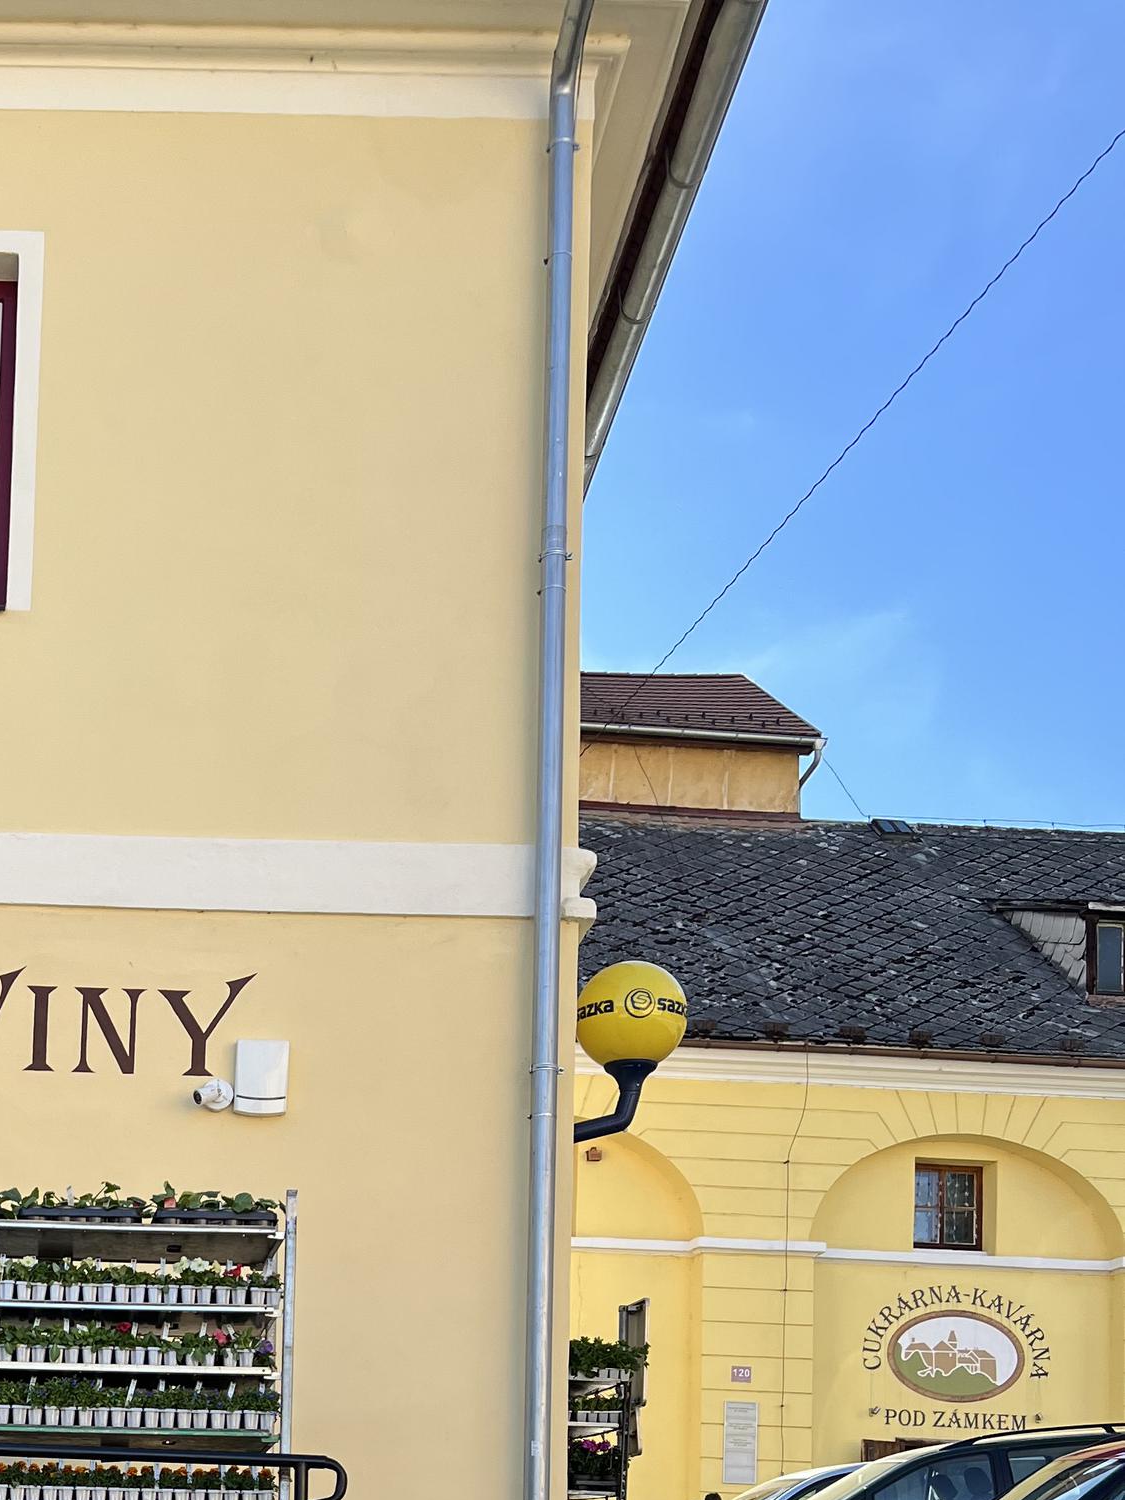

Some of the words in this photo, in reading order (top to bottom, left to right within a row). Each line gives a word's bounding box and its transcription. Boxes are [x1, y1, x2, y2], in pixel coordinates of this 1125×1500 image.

[733, 1368, 750, 1378] 120
[884, 1408, 926, 1427] POD
[932, 1408, 1027, 1431] ZÁMKEM
